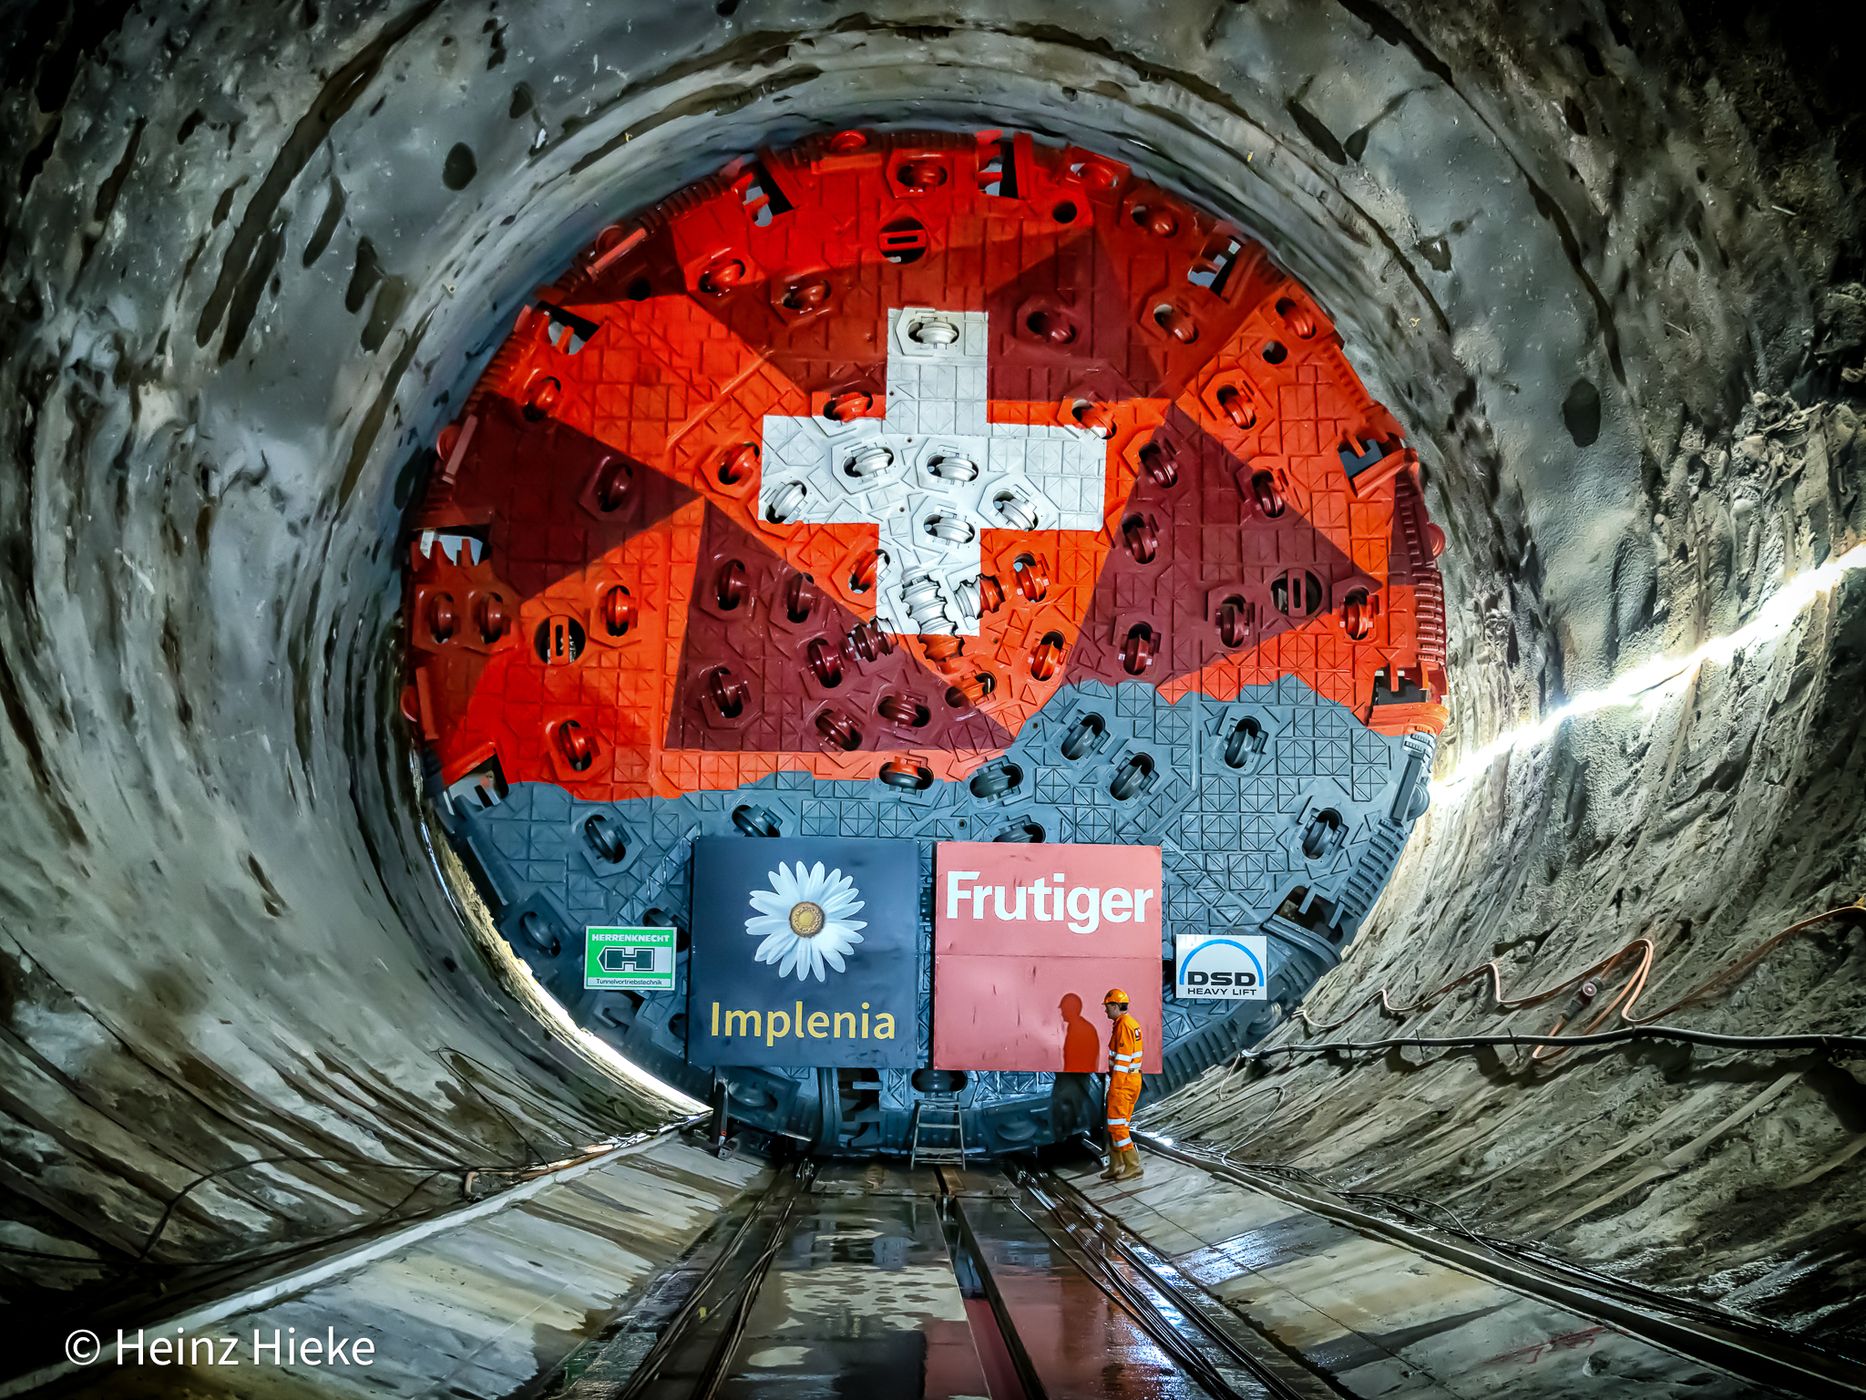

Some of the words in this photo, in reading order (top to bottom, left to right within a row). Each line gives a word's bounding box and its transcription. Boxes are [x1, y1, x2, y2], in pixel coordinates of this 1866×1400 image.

[946, 870, 1154, 934] Frutiger
[591, 934, 670, 942] HERRENKNECHT
[1187, 971, 1256, 986] DSD
[1187, 987, 1228, 996] HEAVY
[1232, 988, 1257, 996] LIFT
[710, 1000, 896, 1047] Implenia
